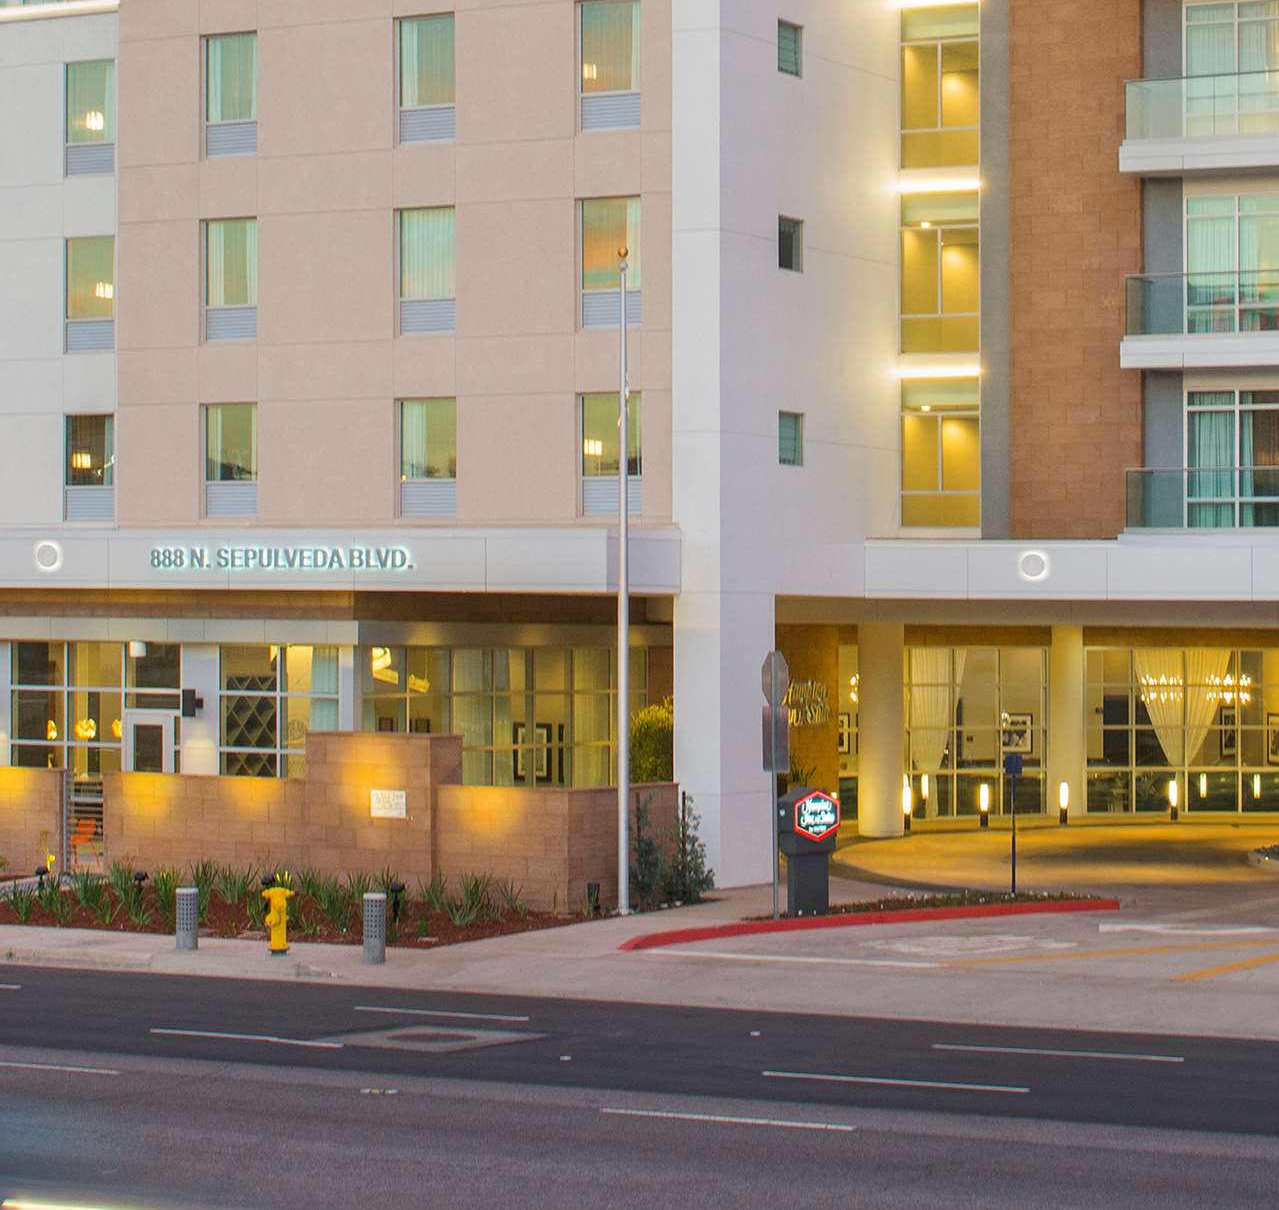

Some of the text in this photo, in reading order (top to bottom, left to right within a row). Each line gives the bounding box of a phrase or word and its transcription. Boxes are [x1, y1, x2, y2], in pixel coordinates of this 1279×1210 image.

[150, 548, 414, 570] 888 N. SEPULVEDA BLVD.
